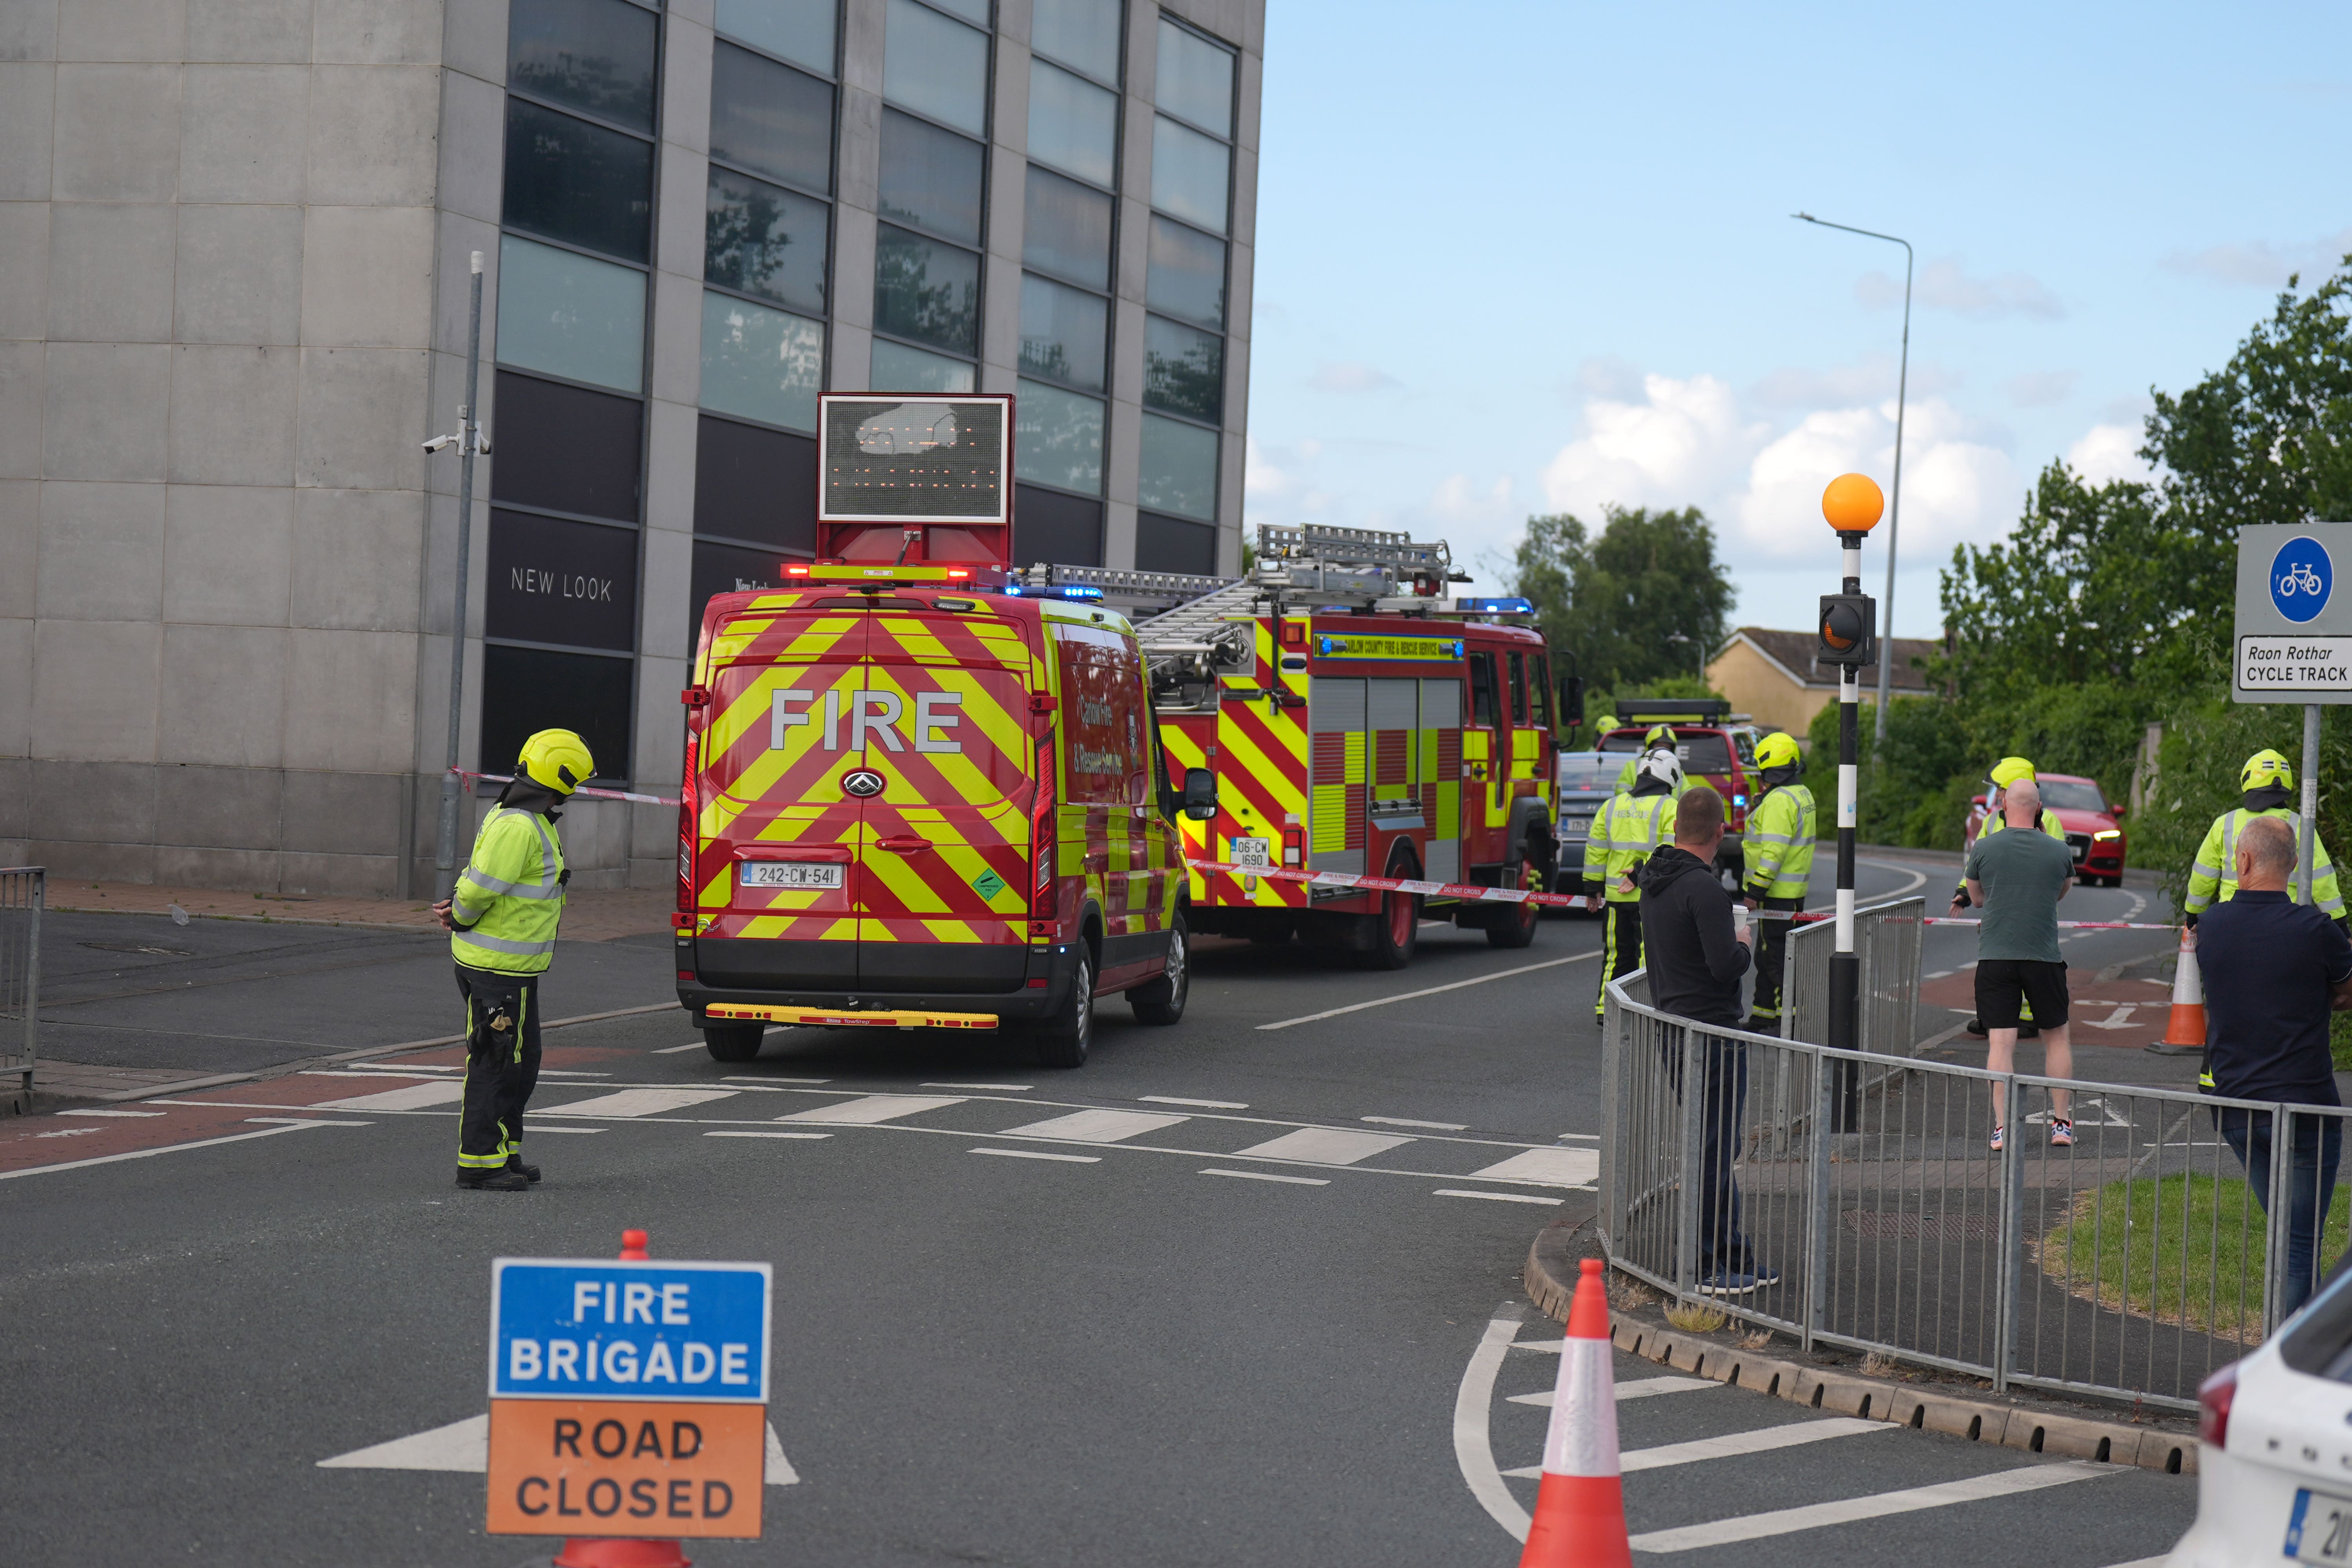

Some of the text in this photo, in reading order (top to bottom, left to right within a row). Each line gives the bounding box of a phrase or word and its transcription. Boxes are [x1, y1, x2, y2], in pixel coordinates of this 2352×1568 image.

[512, 567, 612, 602] NEW LOOK
[735, 578, 751, 592] New
[1365, 640, 1384, 654] COUNTY
[1385, 641, 1395, 655] FIRE
[1401, 641, 1418, 655] RESCUE
[1419, 642, 1437, 655] SERVICE
[2249, 646, 2332, 660] Raon Rothar
[2247, 667, 2347, 681] CYCLE TRACK
[770, 688, 962, 753] FIRE
[1080, 694, 1112, 727] Carlow Fire
[1074, 743, 1123, 776] & Rescue Service
[1614, 810, 1650, 819] RESCUE
[1239, 842, 1266, 853] 06-CW
[1243, 855, 1262, 865] 1690
[759, 868, 833, 883] 242-CW-541
[573, 1281, 690, 1325] FIRE
[510, 1338, 750, 1385] BRIGADE
[553, 1419, 702, 1460] ROAD
[517, 1476, 733, 1519] CLOSED
